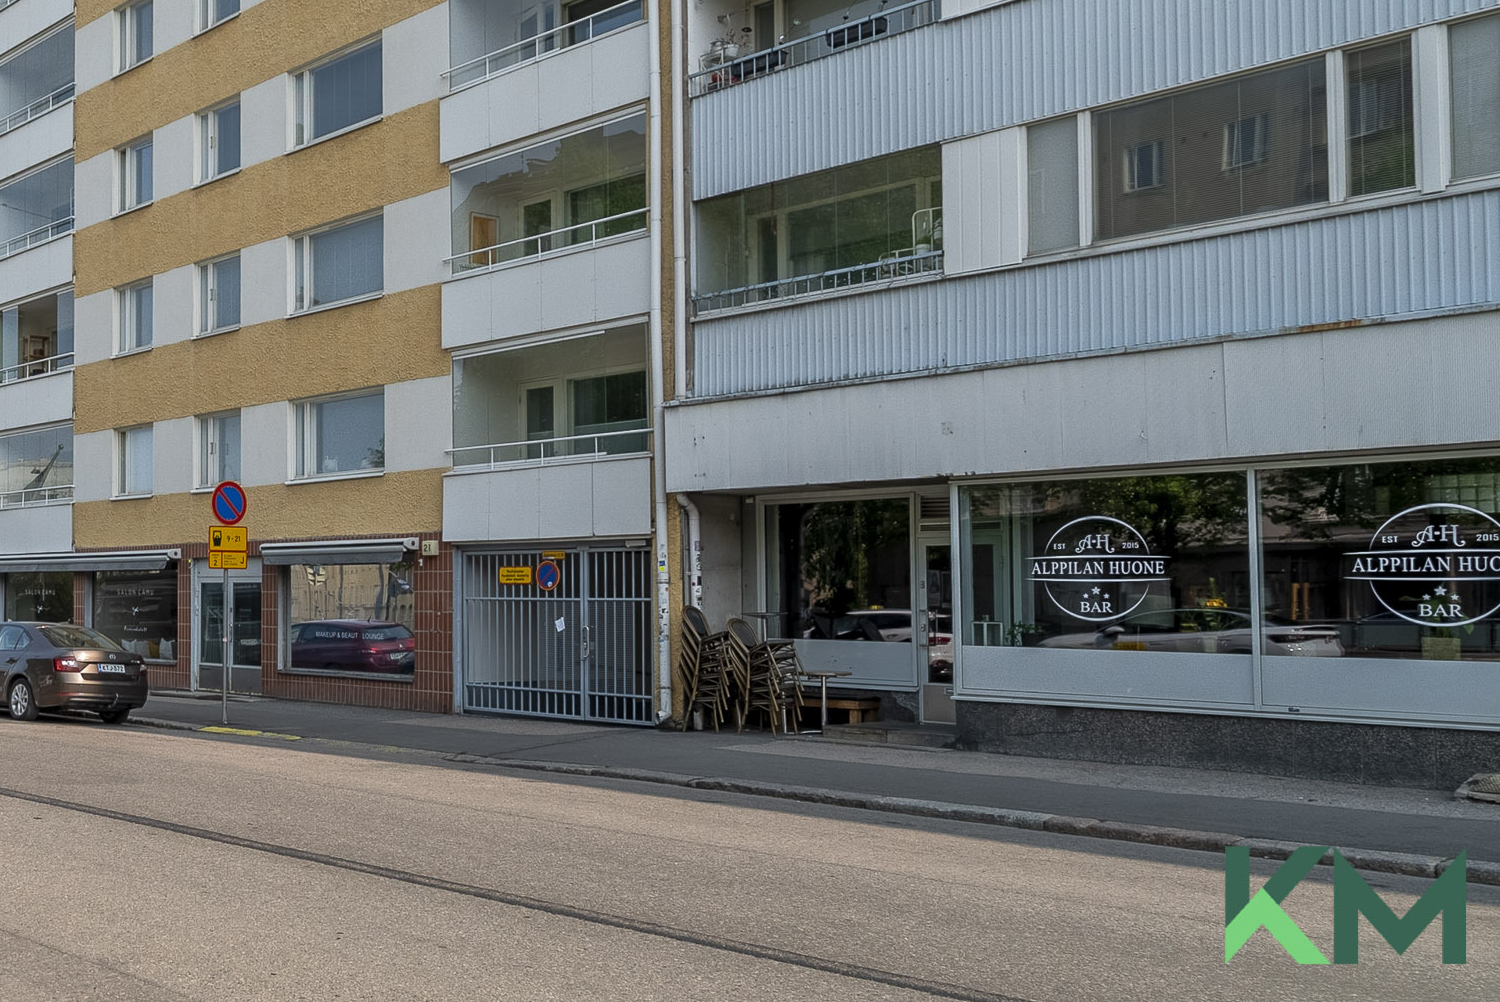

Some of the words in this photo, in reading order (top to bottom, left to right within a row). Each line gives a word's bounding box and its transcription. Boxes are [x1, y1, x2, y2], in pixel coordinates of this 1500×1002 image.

[424, 544, 431, 552] 21
[1031, 561, 1104, 575] ALPPILAN
[1109, 560, 1165, 575] HUONE
[1352, 557, 1451, 573] ALPPILAN
[116, 588, 136, 596] SALON
[1080, 601, 1113, 613] BAR
[1419, 604, 1464, 617] BAR
